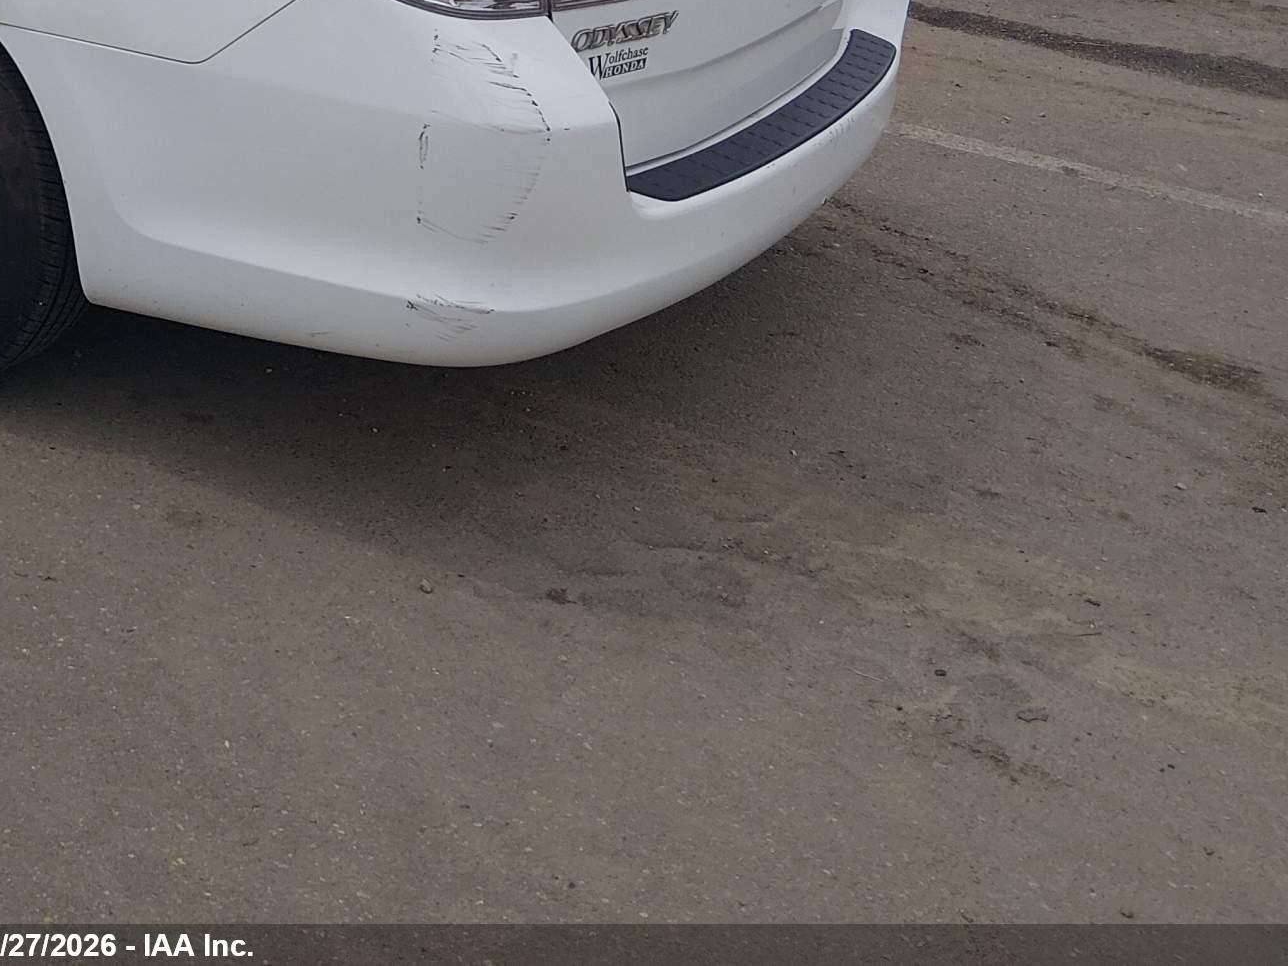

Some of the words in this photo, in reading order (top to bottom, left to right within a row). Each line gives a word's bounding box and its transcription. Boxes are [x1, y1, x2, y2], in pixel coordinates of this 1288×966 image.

[571, 10, 679, 53] ODYSSEY
[588, 46, 649, 81] Wolfchase
[603, 59, 647, 78] HONDA
